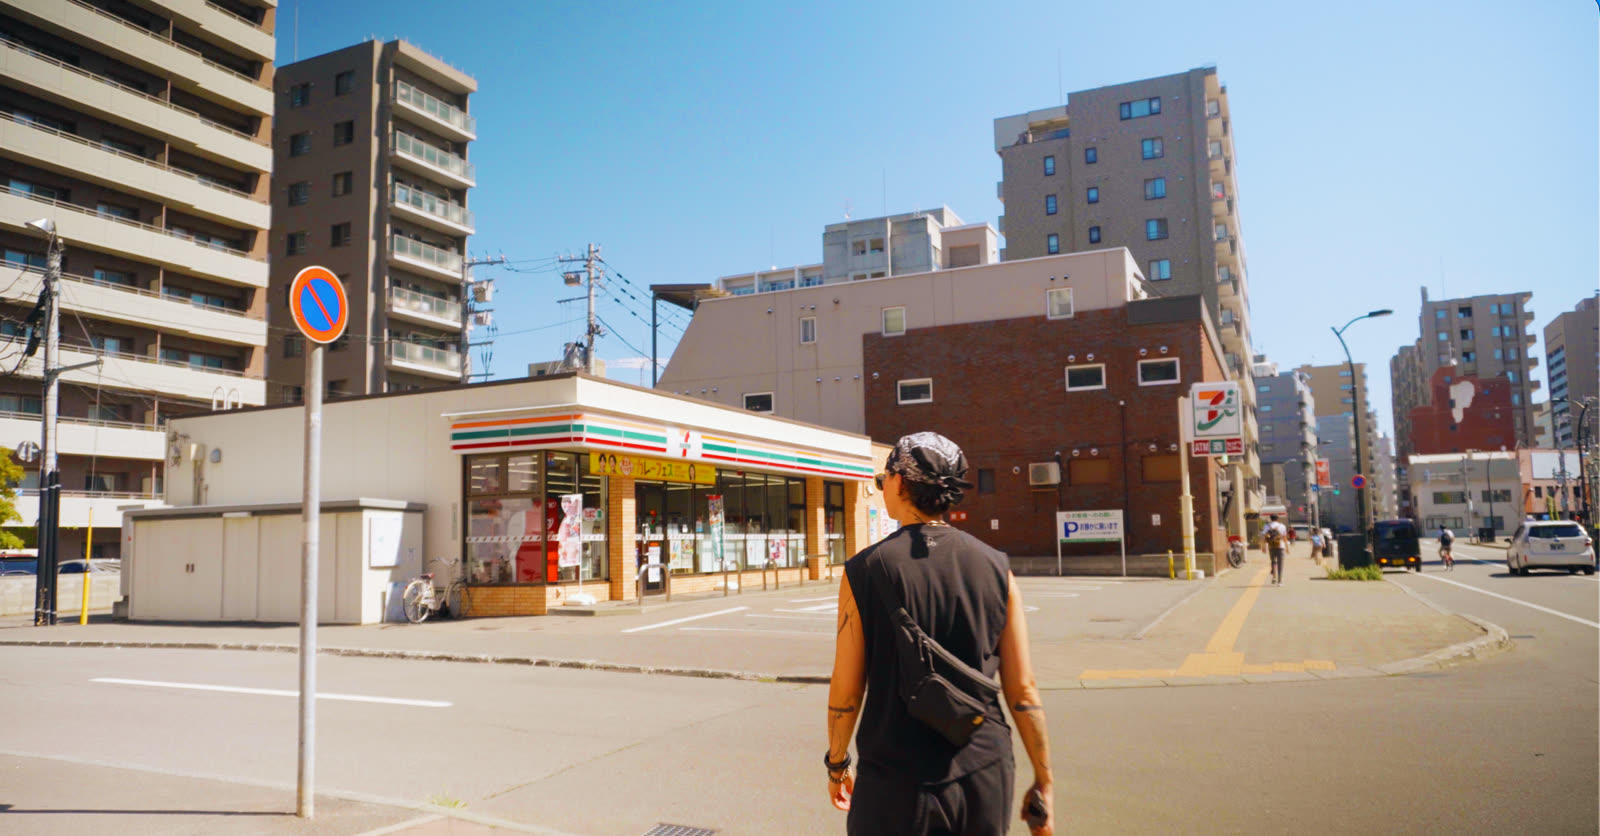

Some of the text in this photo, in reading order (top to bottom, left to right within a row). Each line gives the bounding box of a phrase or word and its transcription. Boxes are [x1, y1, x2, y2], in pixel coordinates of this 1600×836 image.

[1194, 442, 1209, 453] ATM
[634, 459, 673, 477] カレーフェス
[1064, 521, 1079, 538] P
